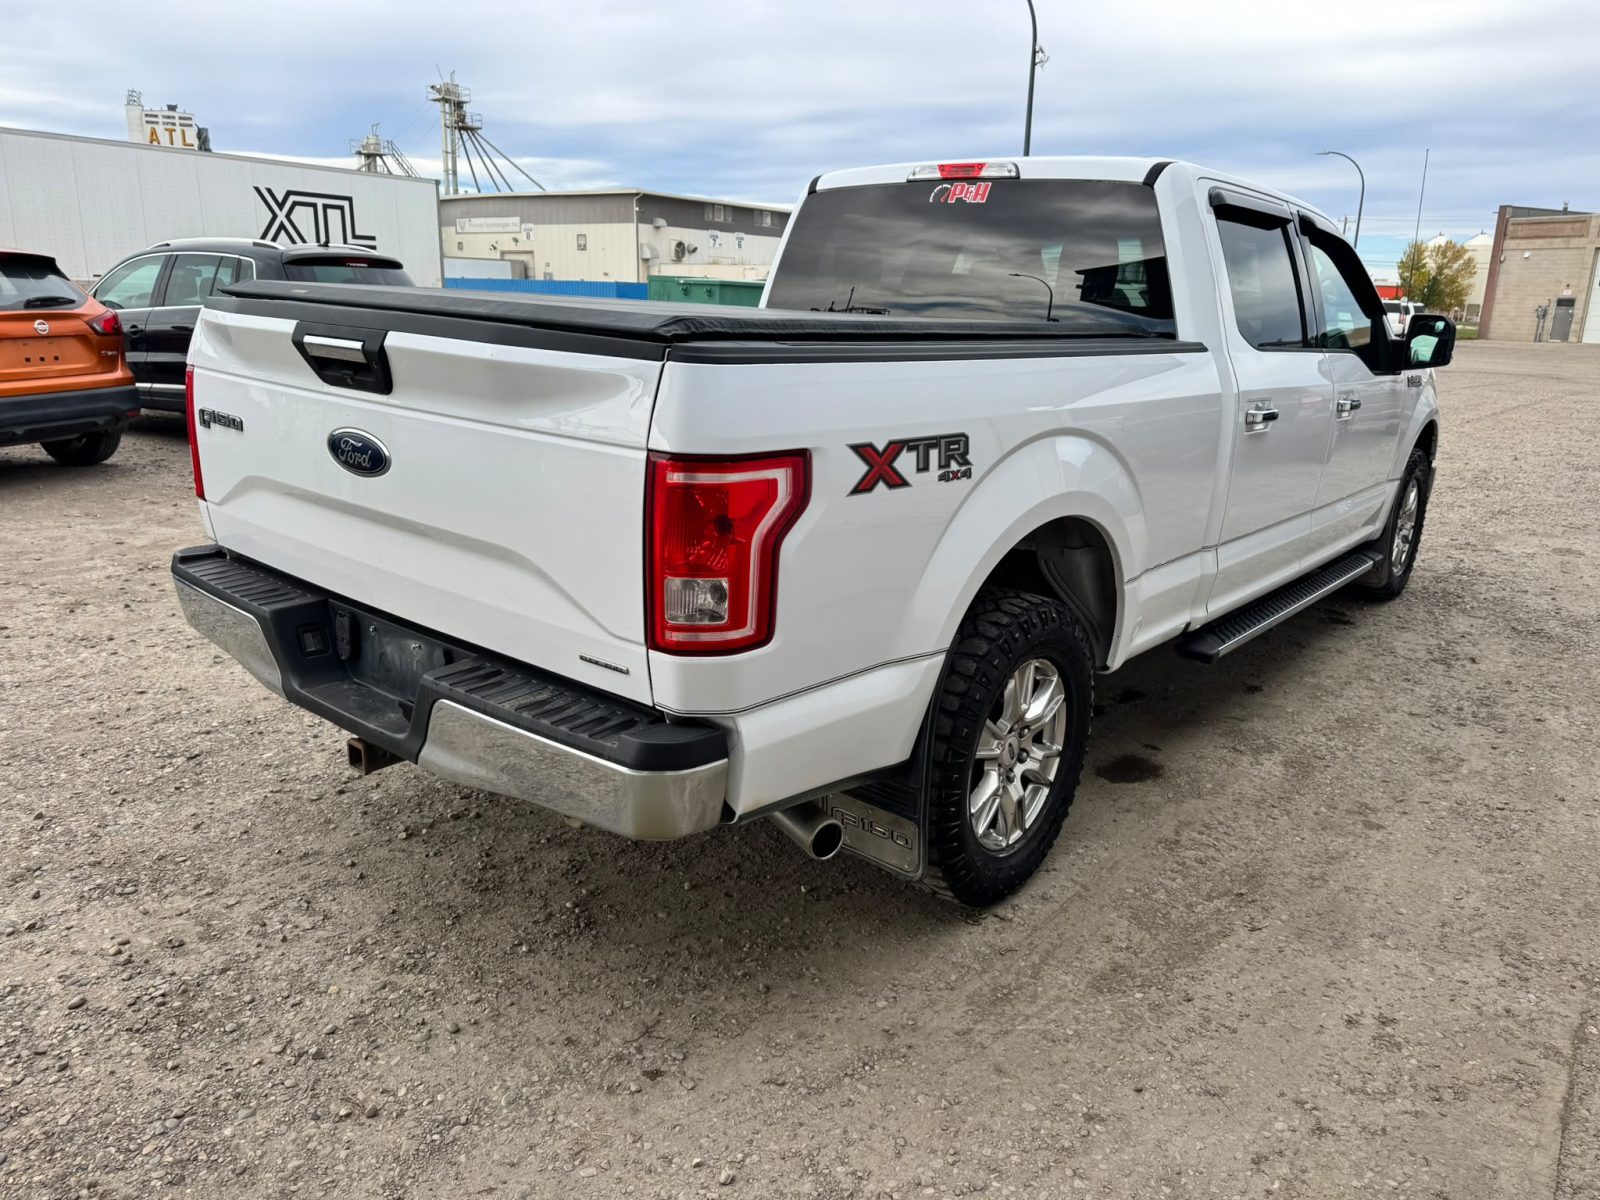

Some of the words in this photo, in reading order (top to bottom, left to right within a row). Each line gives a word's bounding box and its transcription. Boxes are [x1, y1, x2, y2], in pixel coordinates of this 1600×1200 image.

[149, 126, 194, 147] ATL
[948, 182, 992, 203] P&H
[253, 186, 377, 250] XTL
[338, 437, 372, 468] Ford
[845, 432, 973, 497] XTR
